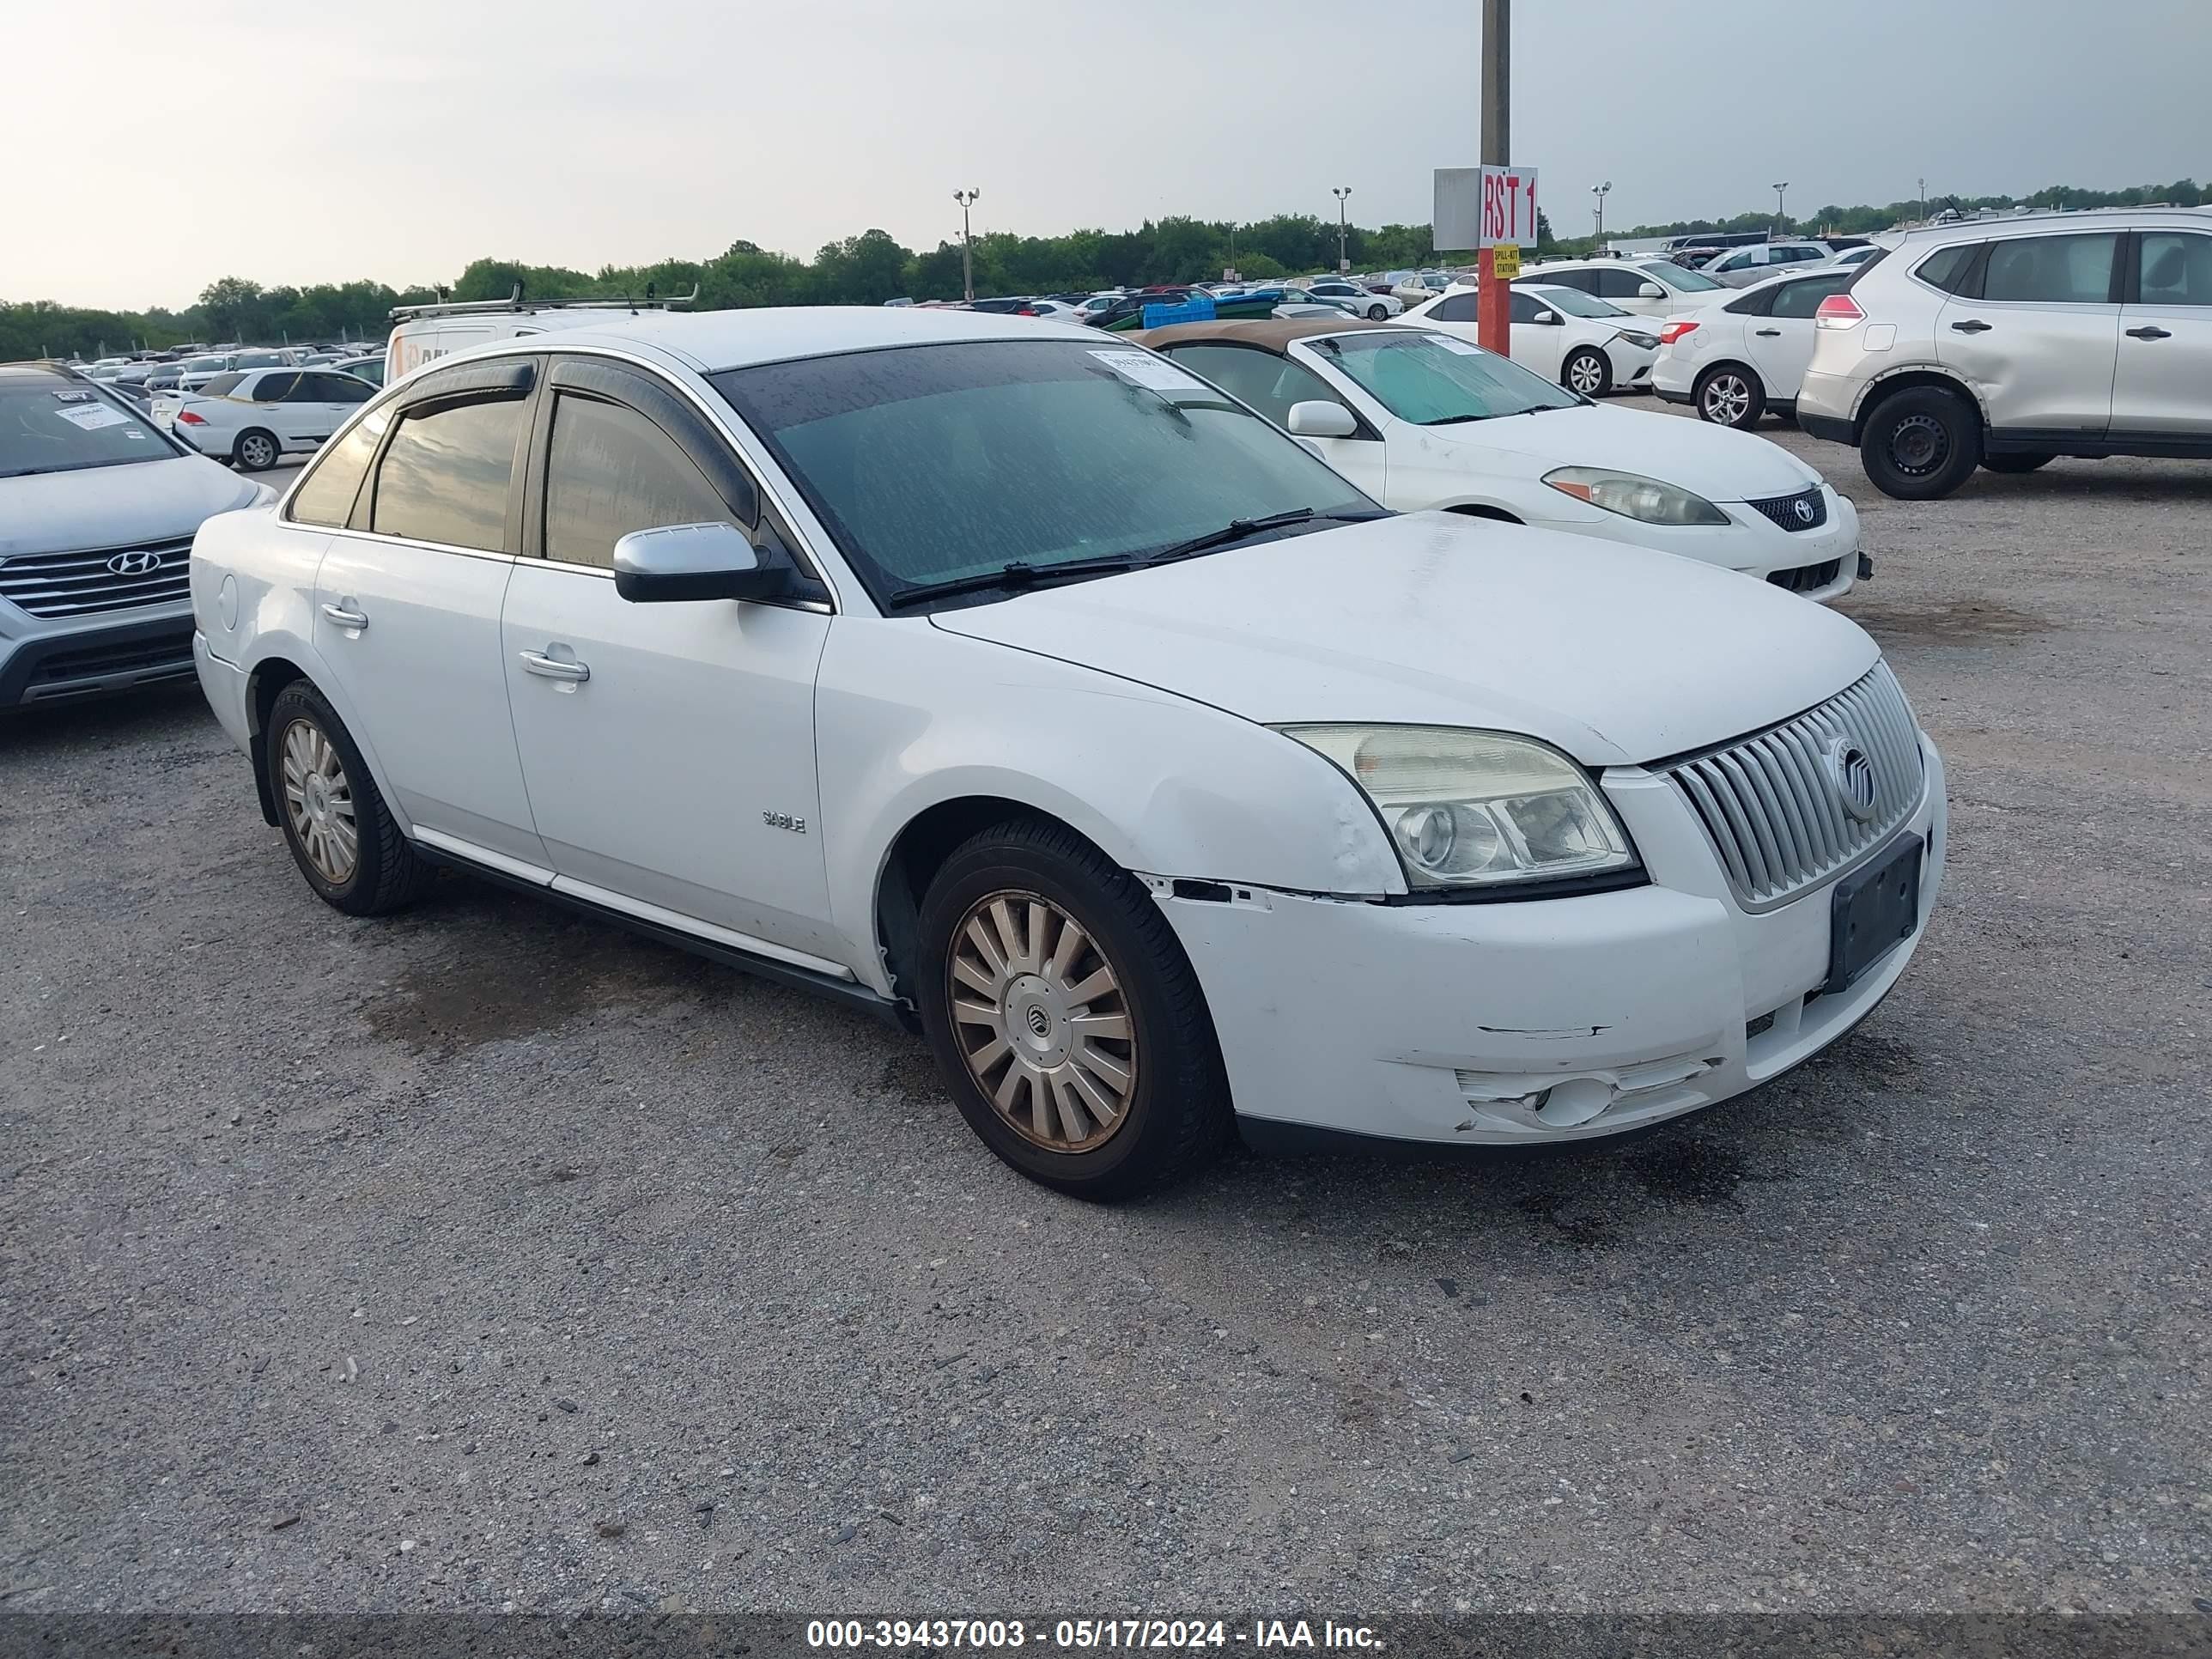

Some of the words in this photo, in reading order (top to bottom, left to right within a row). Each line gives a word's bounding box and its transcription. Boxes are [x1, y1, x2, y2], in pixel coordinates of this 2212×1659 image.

[1484, 175, 1519, 240] RST
[1527, 177, 1534, 239] 1
[1495, 250, 1518, 260] SPILL-KIT
[1497, 263, 1517, 273] STATION
[762, 810, 806, 834] SABLE
